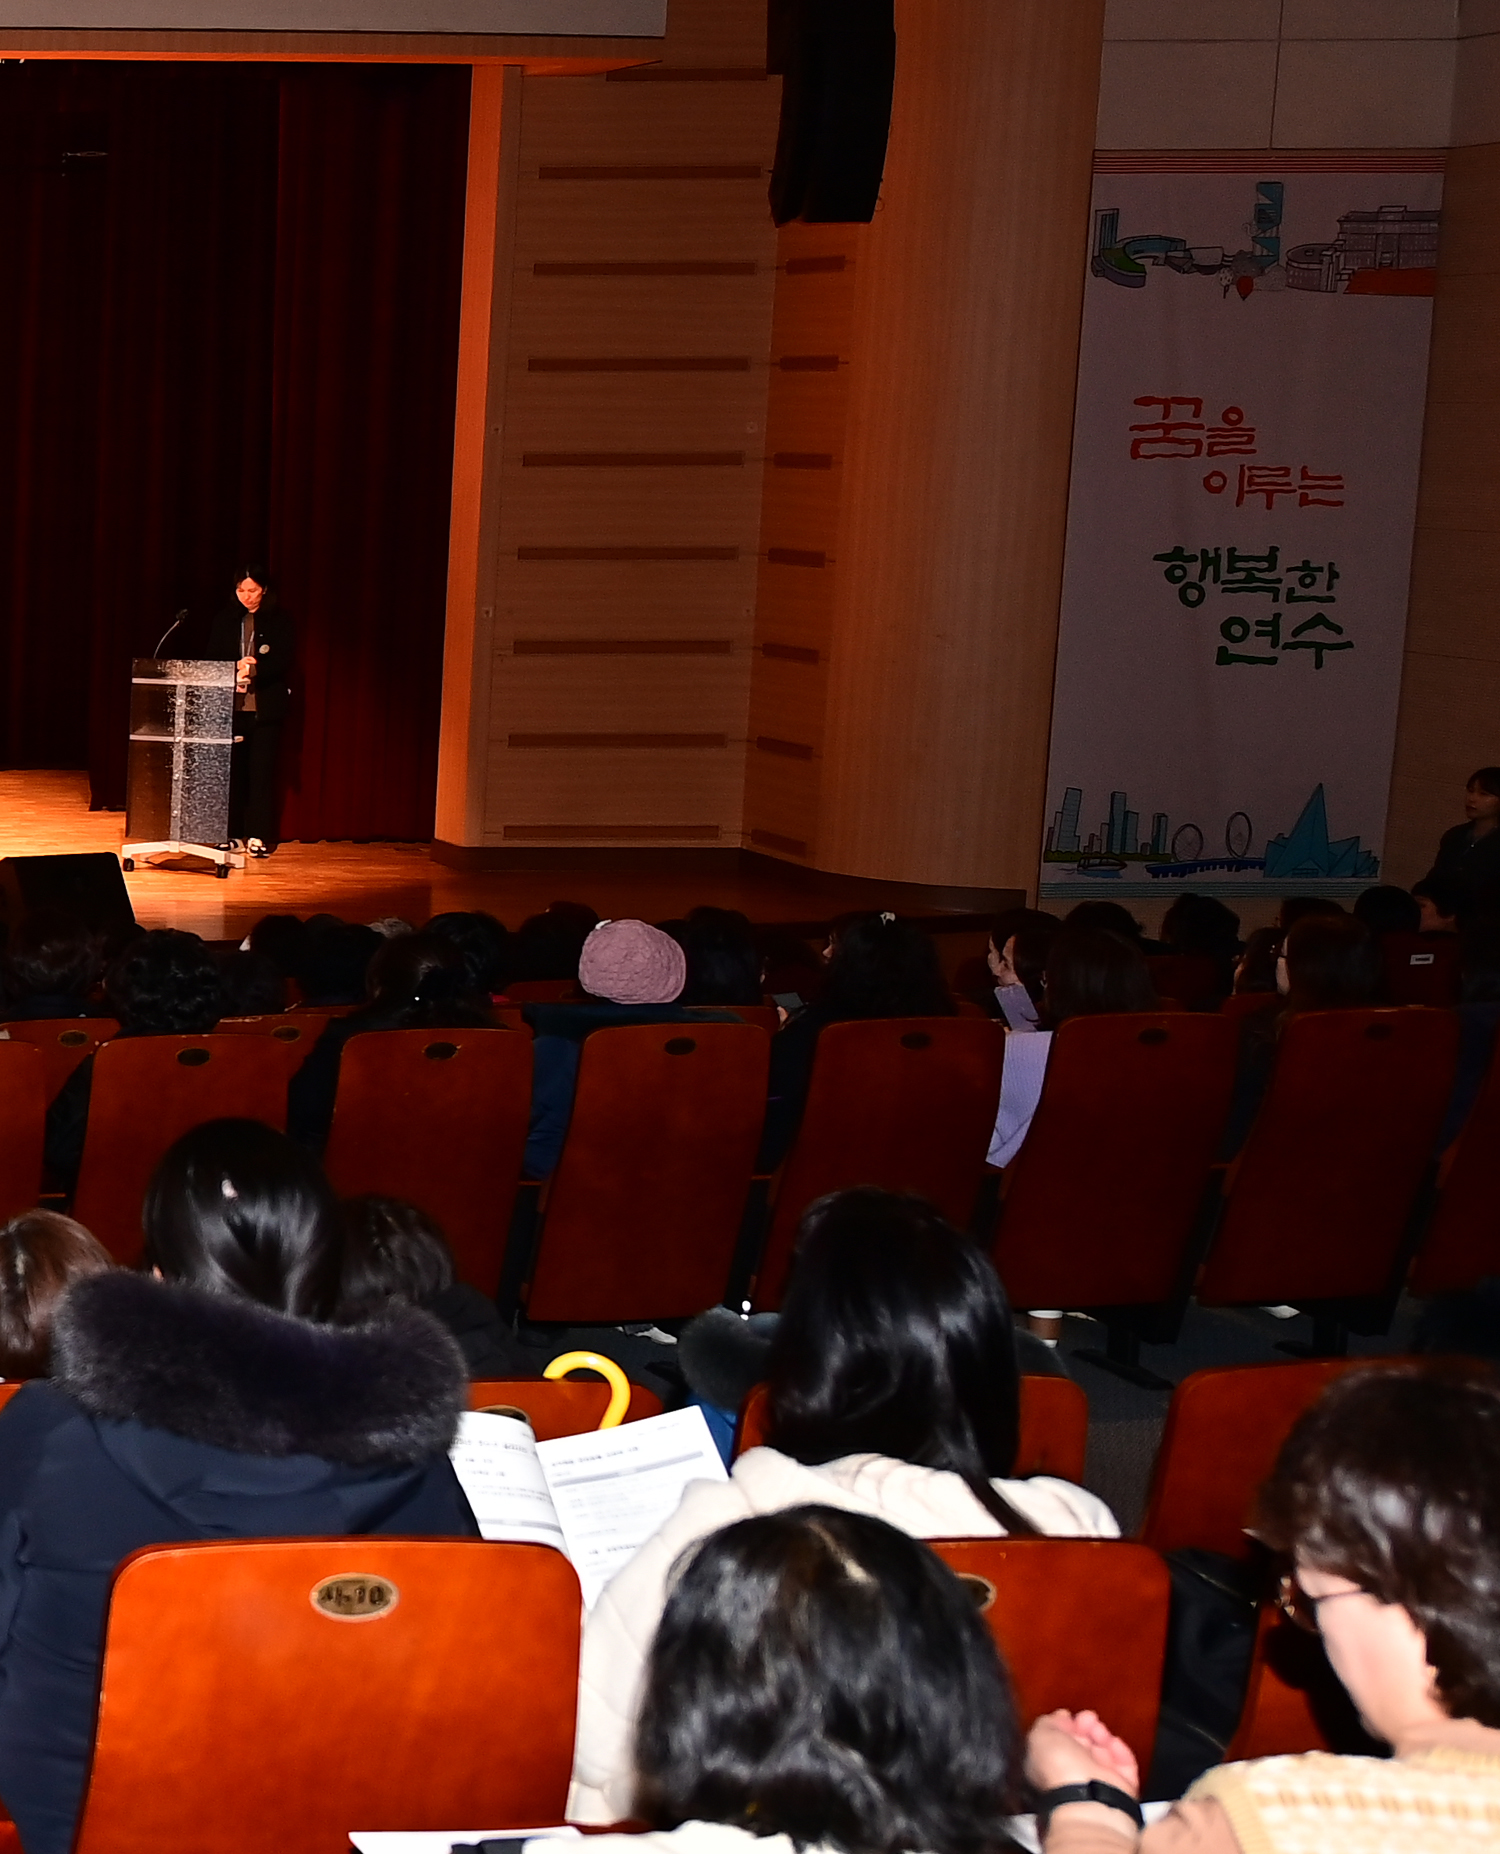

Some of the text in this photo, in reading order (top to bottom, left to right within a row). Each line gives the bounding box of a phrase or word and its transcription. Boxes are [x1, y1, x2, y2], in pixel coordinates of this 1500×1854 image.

[1129, 396, 1257, 460] 꿈을
[1202, 464, 1345, 510] 이루는
[1152, 546, 1340, 608] 행복한
[1215, 612, 1355, 671] 연수
